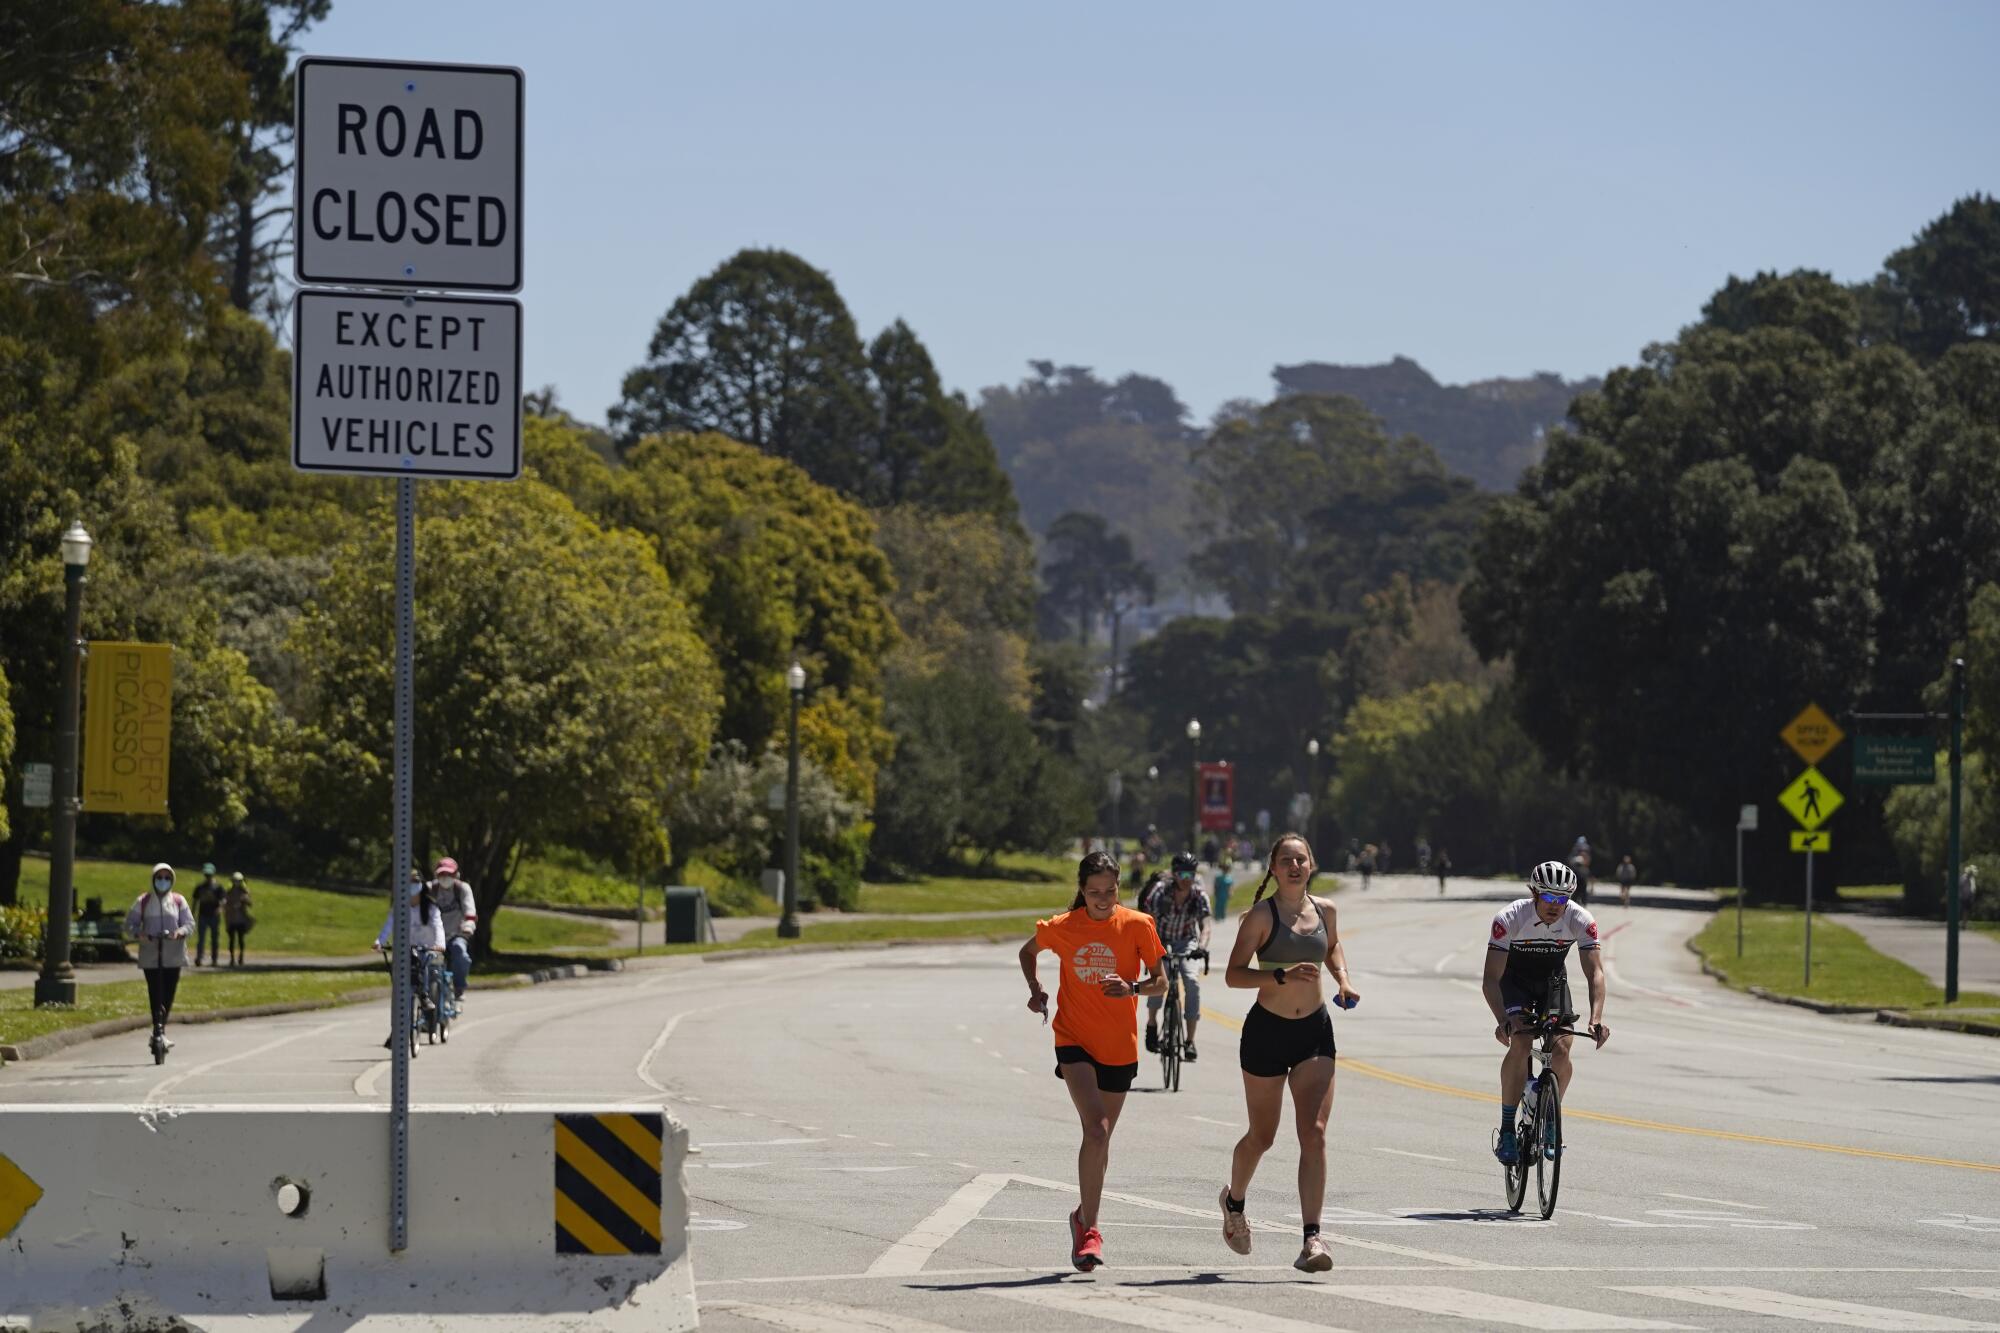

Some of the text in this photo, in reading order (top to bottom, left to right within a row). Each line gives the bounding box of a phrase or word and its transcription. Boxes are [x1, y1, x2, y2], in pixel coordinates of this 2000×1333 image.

[337, 103, 484, 161] ROAD
[312, 187, 507, 248] CLOSED
[336, 311, 486, 352] EXCEPT
[315, 363, 501, 406] AUTHORIZED
[321, 416, 495, 459] VEHICLES
[112, 651, 141, 776] PICASSO
